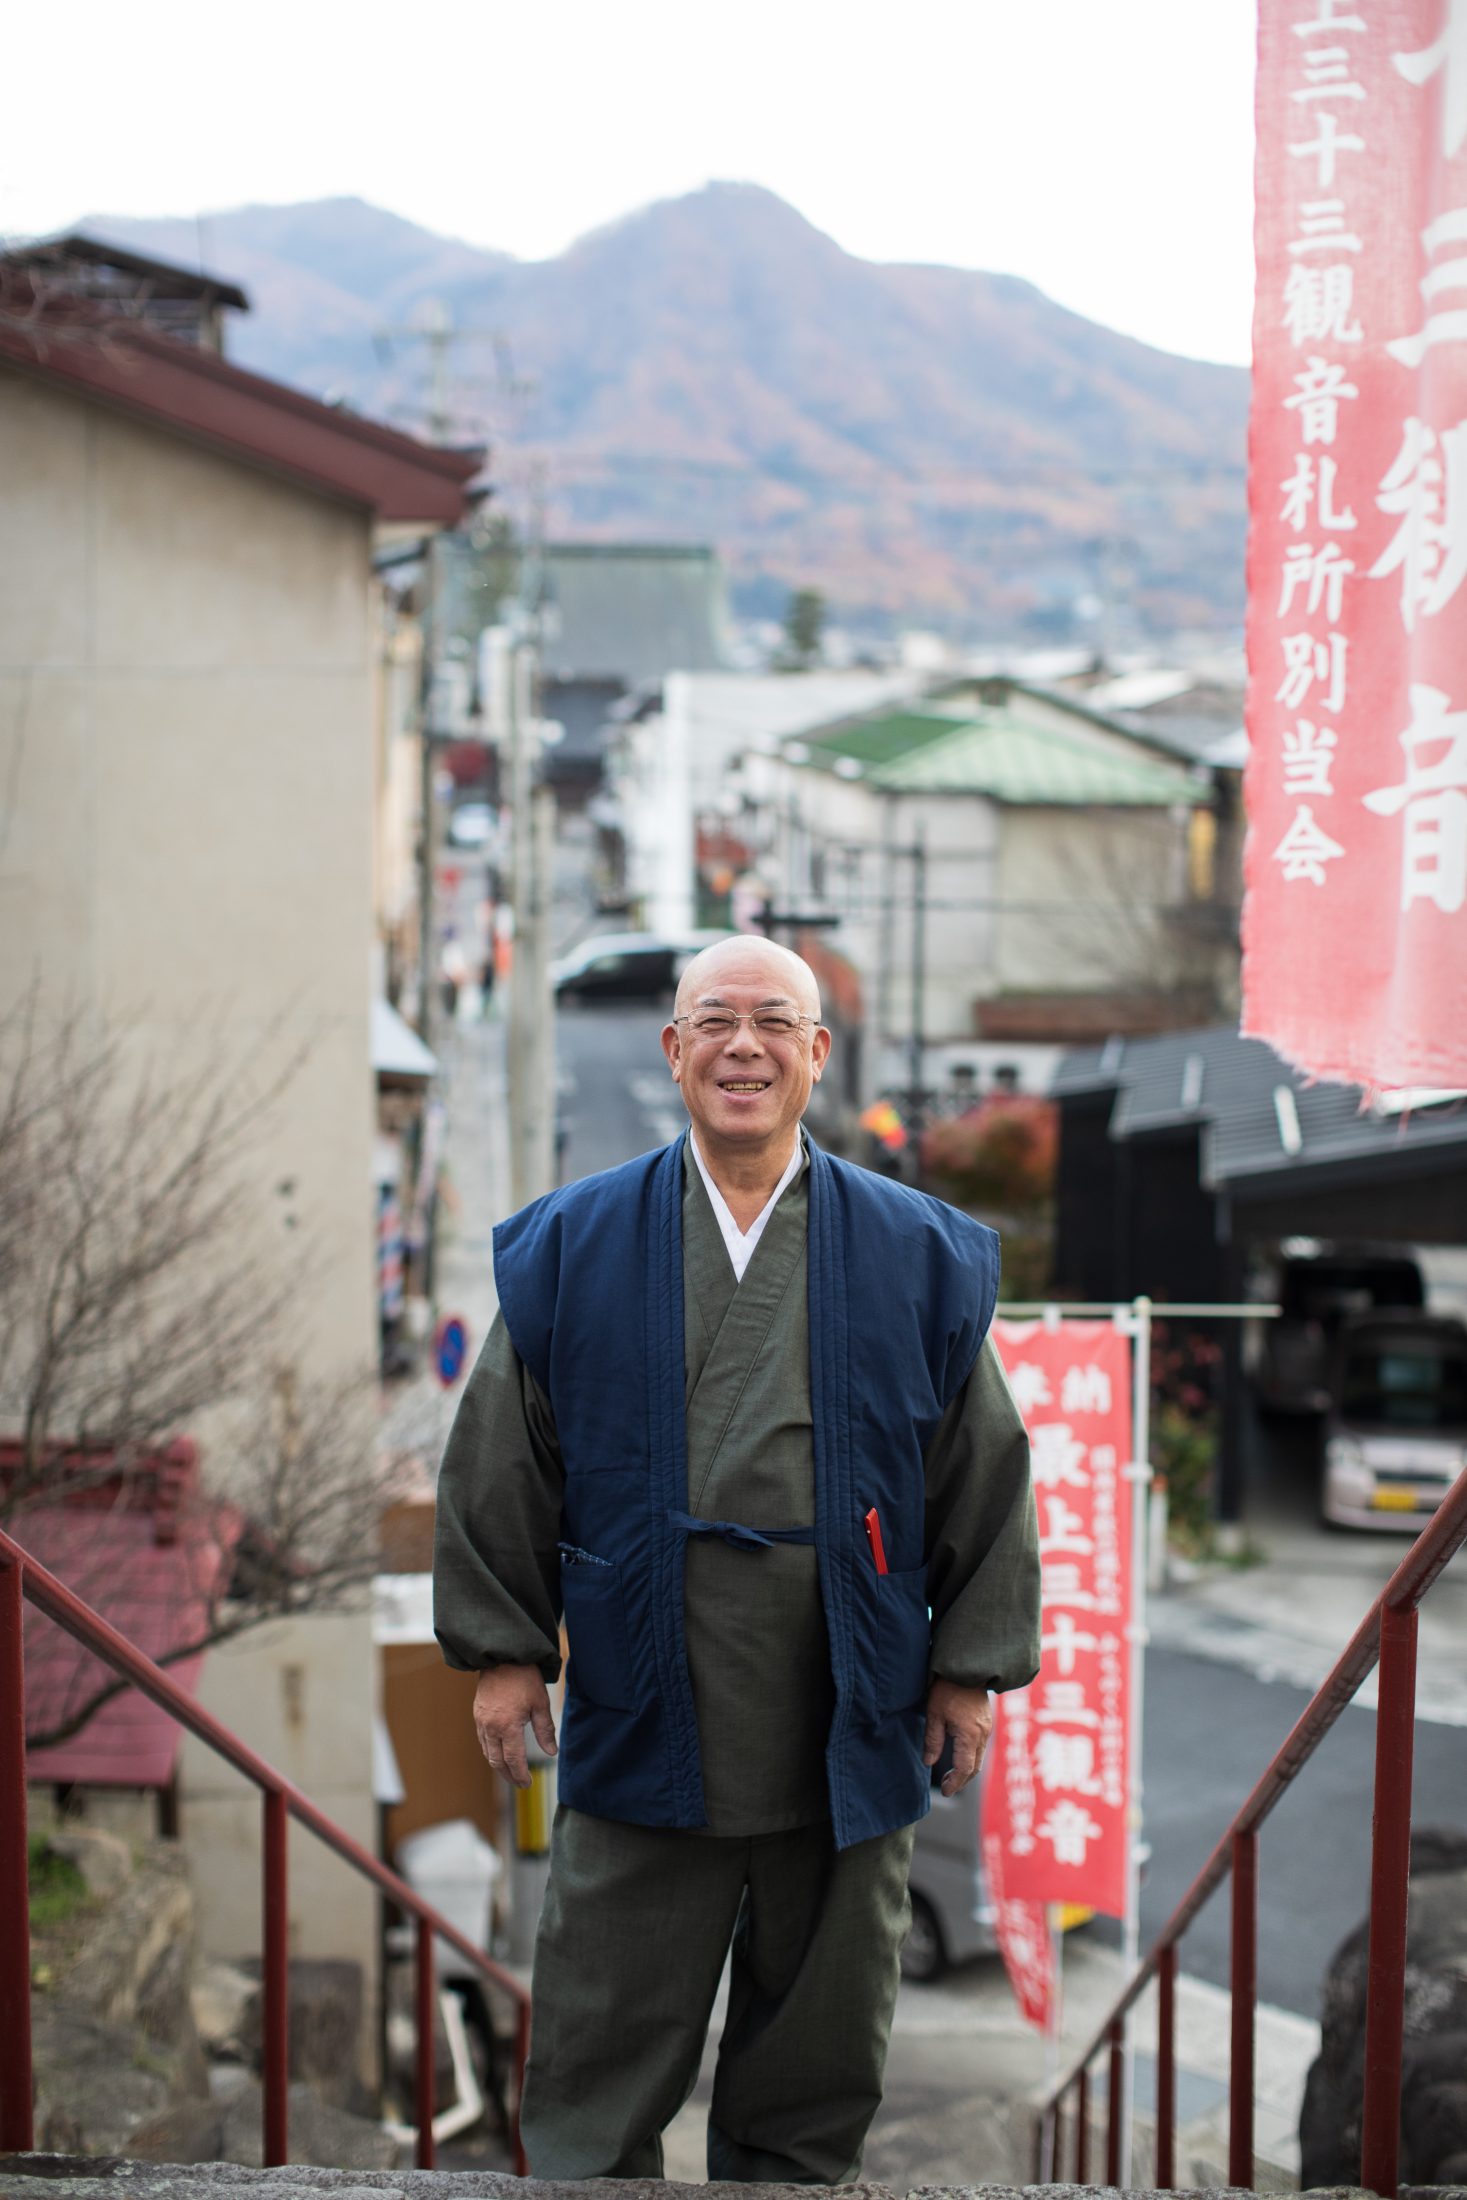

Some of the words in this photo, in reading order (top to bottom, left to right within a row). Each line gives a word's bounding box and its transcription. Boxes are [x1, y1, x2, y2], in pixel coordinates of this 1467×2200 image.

[1030, 1422, 1102, 1867] 最上三十三観音
